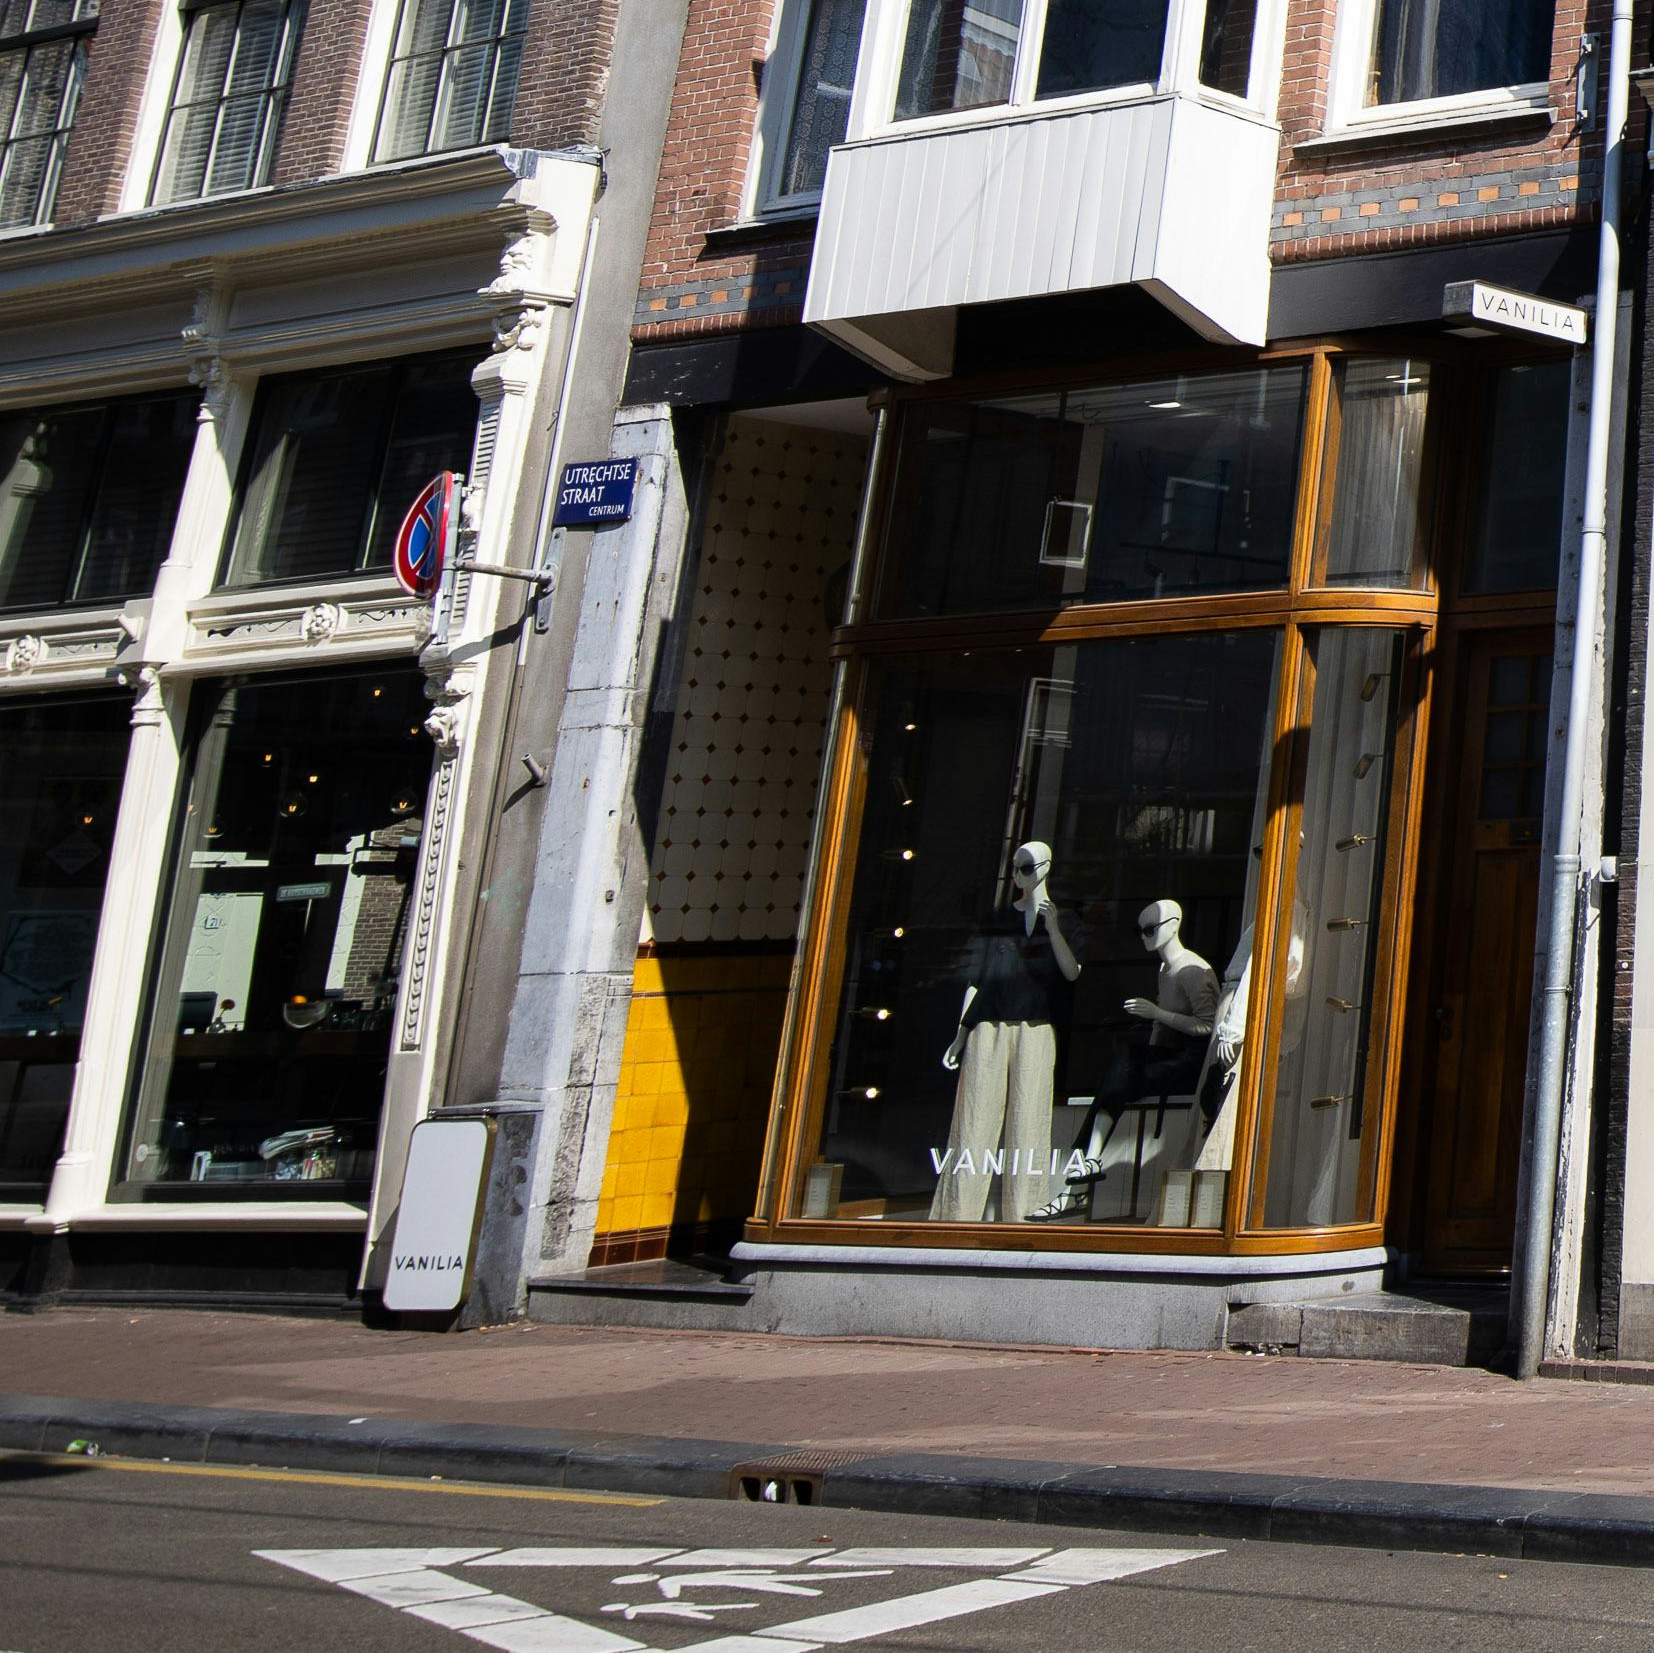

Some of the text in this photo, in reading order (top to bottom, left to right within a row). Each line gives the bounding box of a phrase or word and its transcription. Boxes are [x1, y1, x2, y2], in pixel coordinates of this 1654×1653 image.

[1481, 292, 1574, 332] VANILIA
[565, 463, 632, 485] UTRECHTSE
[561, 486, 605, 505] STRAAT
[588, 504, 625, 517] CENTRUM
[930, 1148, 1086, 1176] VANILIA
[395, 1255, 464, 1271] VANILIA
